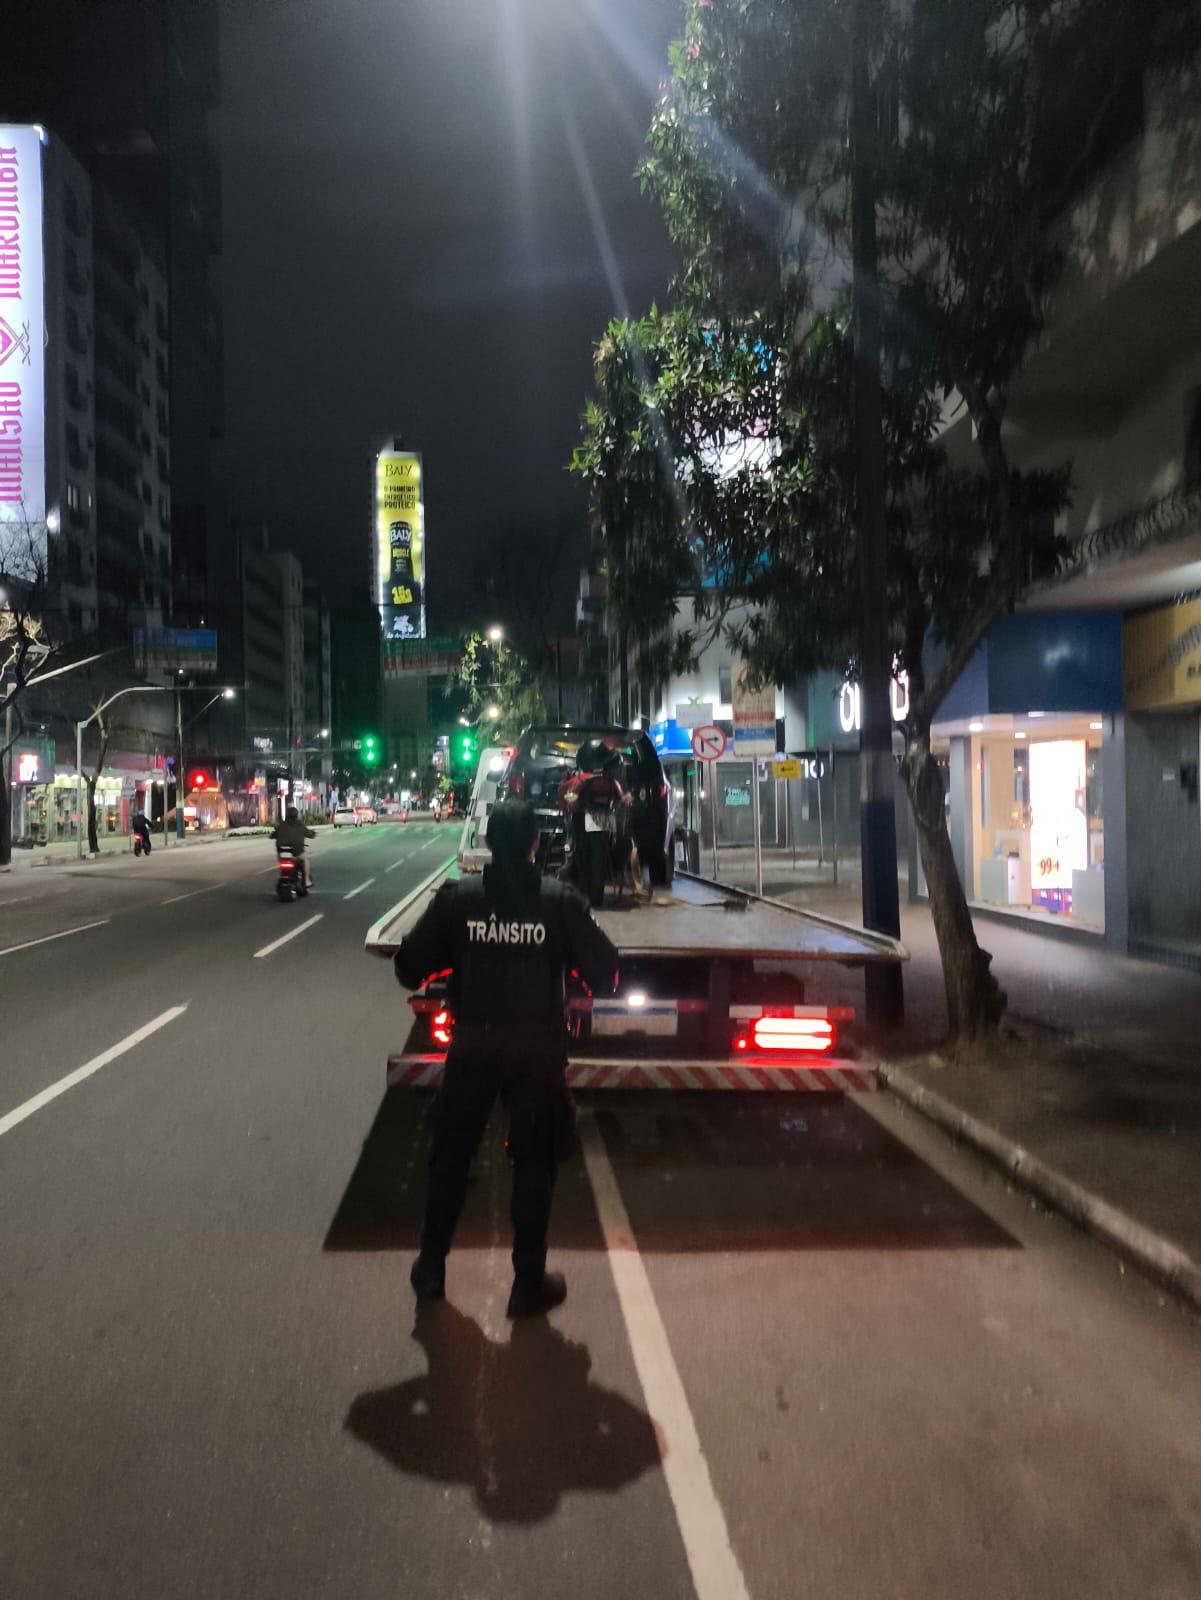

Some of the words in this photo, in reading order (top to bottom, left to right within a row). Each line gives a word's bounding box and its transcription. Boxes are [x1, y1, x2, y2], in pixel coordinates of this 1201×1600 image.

[385, 463, 413, 477] BALY
[390, 528, 411, 542] BALY
[467, 913, 546, 944] TRÂNSITO
